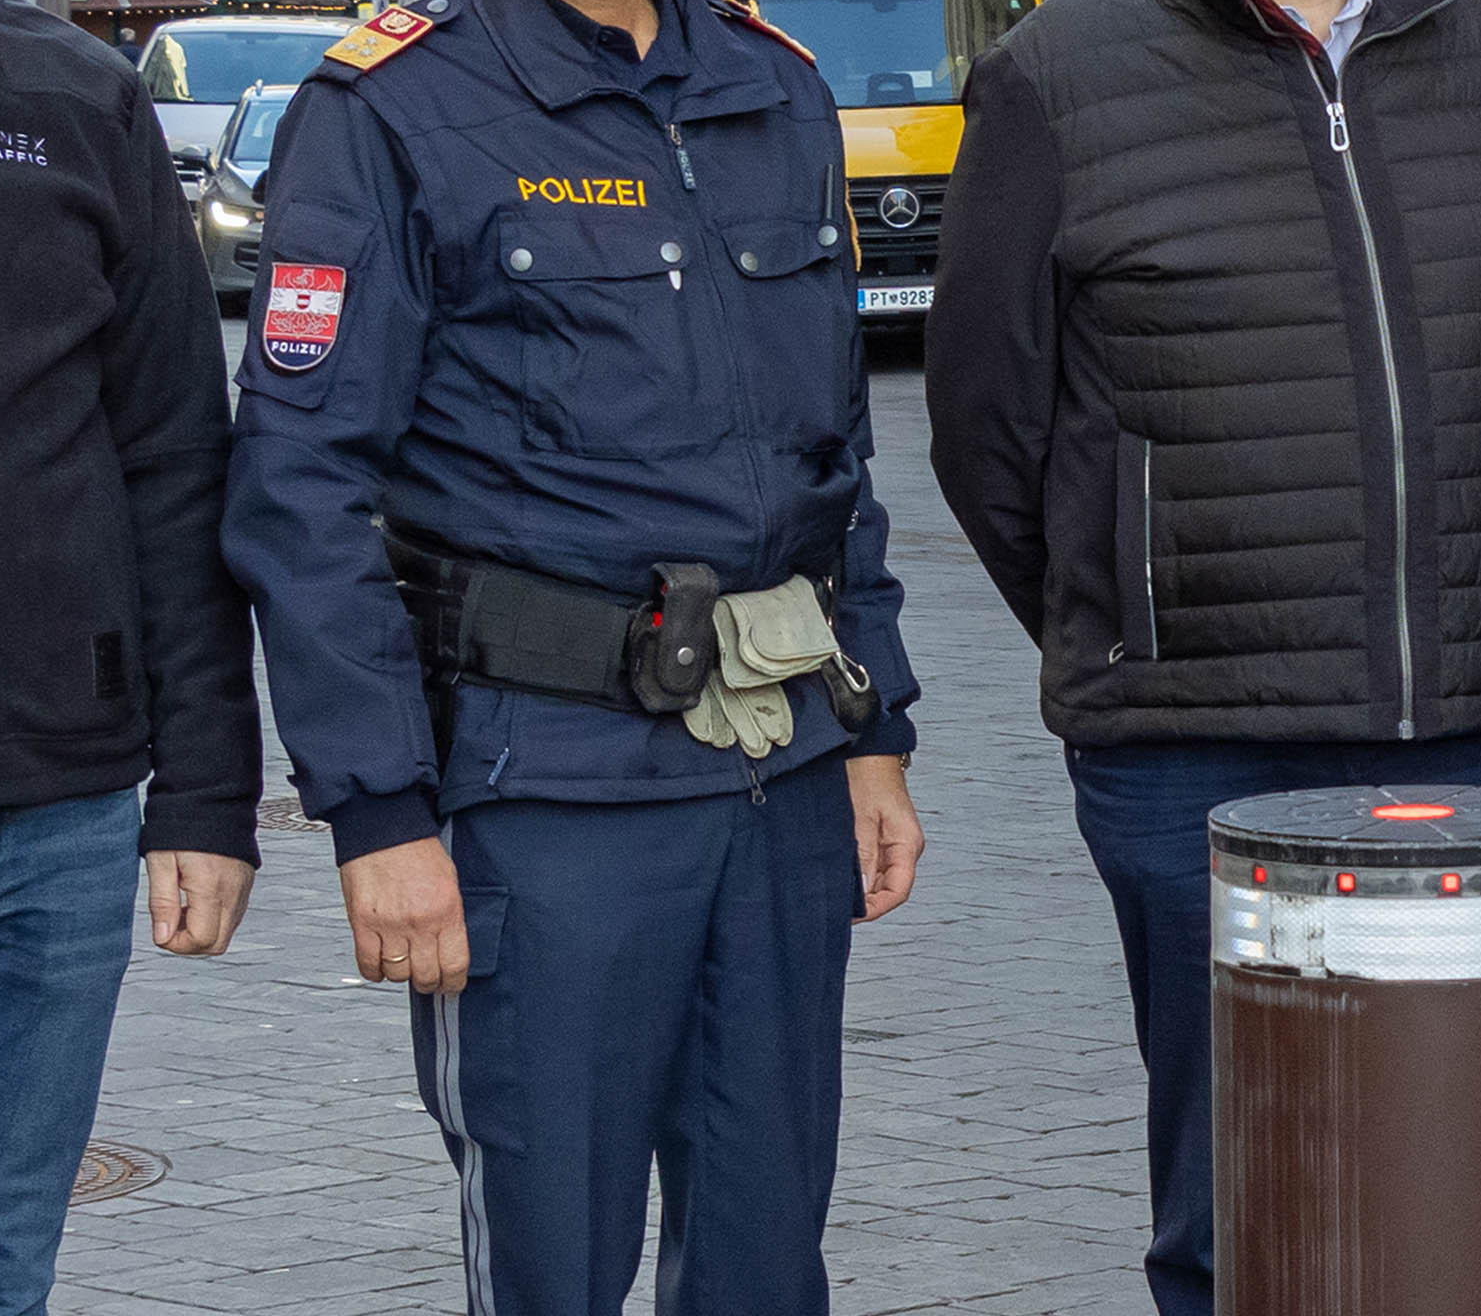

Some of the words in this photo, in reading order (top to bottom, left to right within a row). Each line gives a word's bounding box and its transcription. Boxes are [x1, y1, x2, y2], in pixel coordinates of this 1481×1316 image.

[518, 177, 648, 207] POLIZEI
[870, 292, 888, 306] PT
[271, 341, 322, 356] POLIZEI
